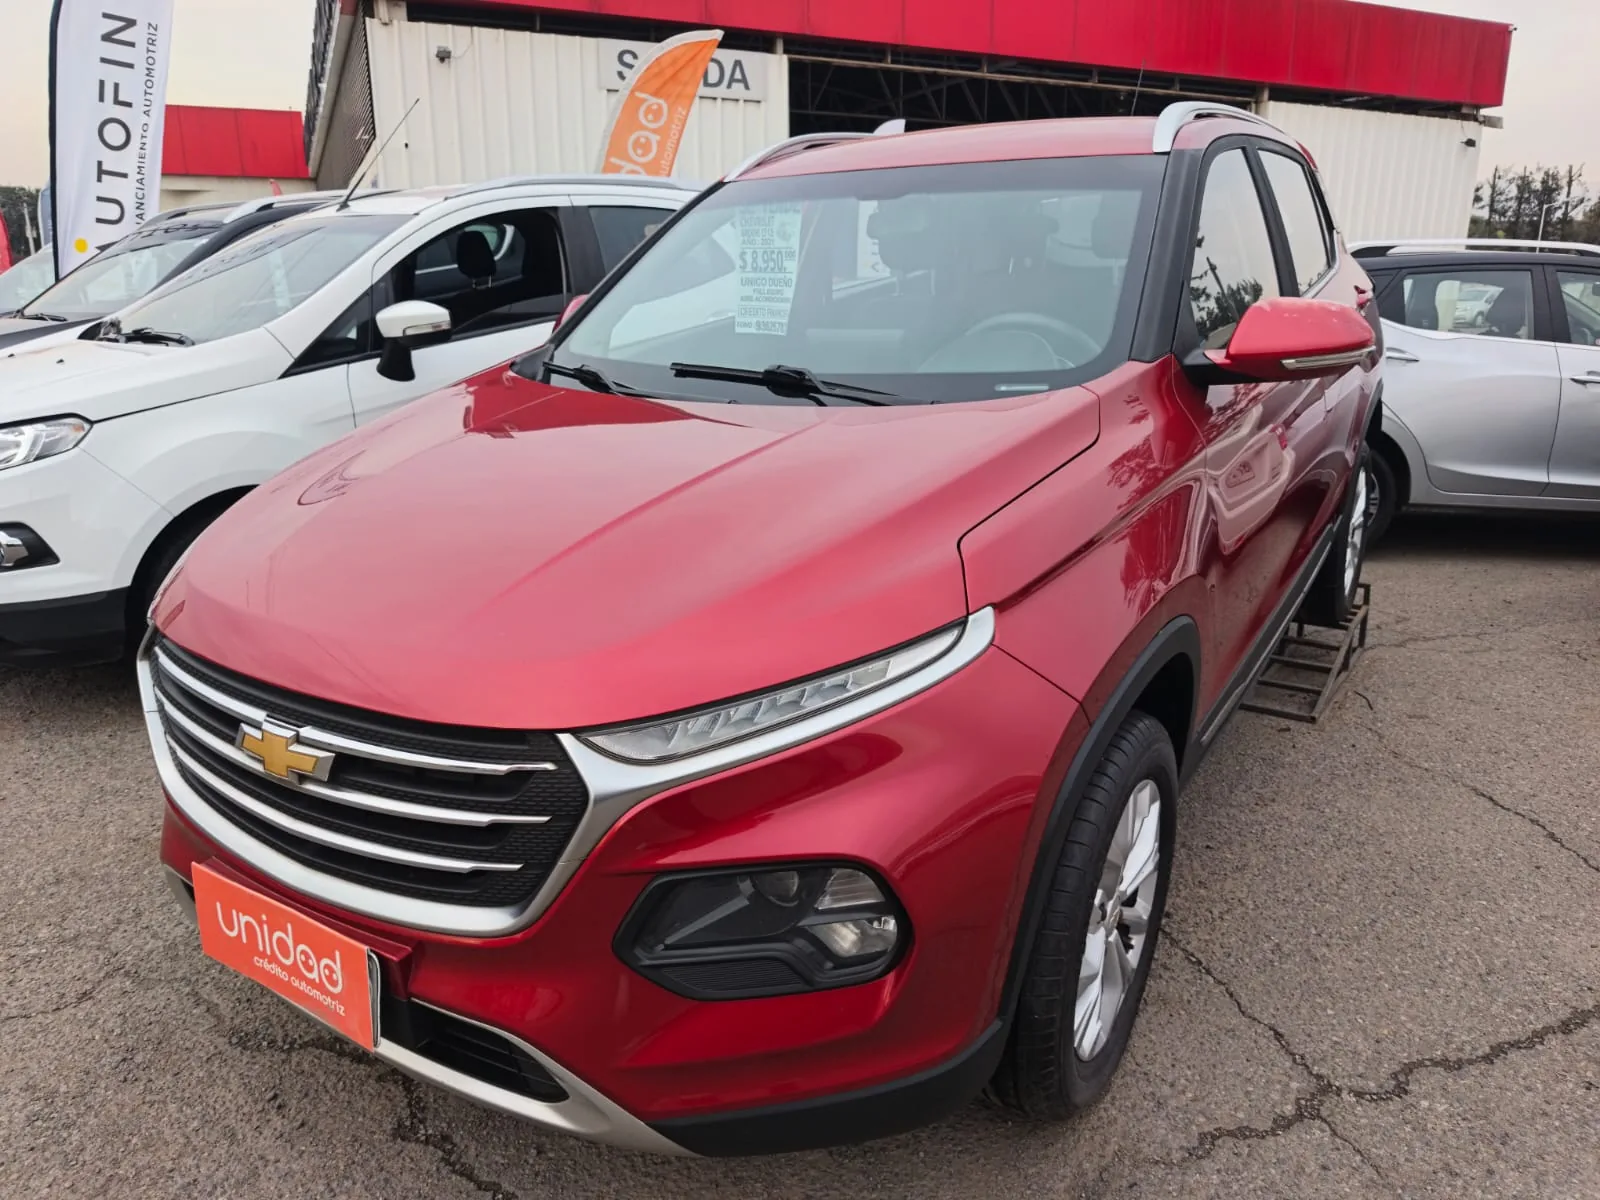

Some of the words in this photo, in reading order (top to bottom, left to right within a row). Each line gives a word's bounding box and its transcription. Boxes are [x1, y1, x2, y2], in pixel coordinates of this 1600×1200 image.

[616, 48, 751, 91] SDA
[135, 121, 151, 225] ANCIAMIENTO
[143, 21, 159, 118] AUTOMOTRIZ
[215, 900, 343, 994] unidad
[253, 955, 289, 982] crédito
[290, 975, 346, 1017] automotriz
